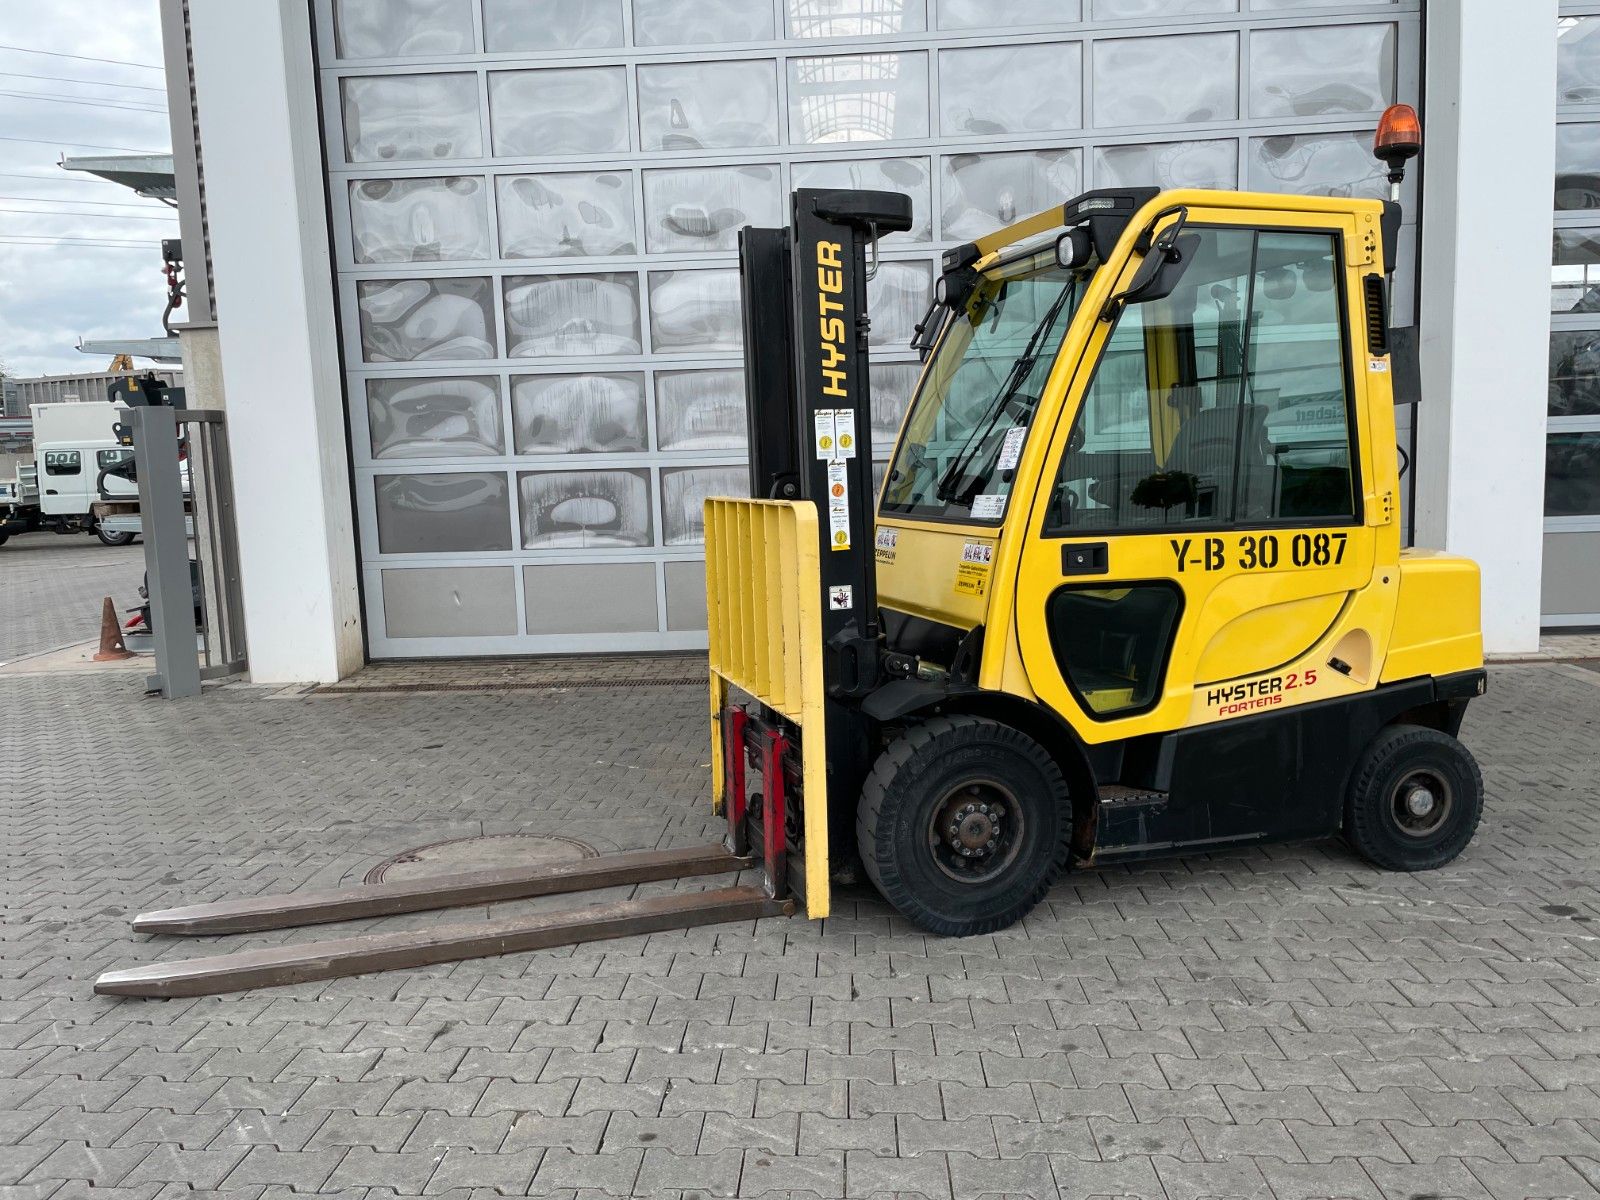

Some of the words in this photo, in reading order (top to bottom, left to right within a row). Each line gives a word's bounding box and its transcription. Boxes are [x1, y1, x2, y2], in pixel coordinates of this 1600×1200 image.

[816, 240, 848, 397] HYSTER
[1170, 538, 1225, 572] Y-B
[1238, 535, 1279, 570] 30
[1292, 533, 1348, 567] 087
[1207, 676, 1282, 706] HYSTER
[1284, 669, 1317, 690] 2.5
[1219, 694, 1282, 716] FORTENS
